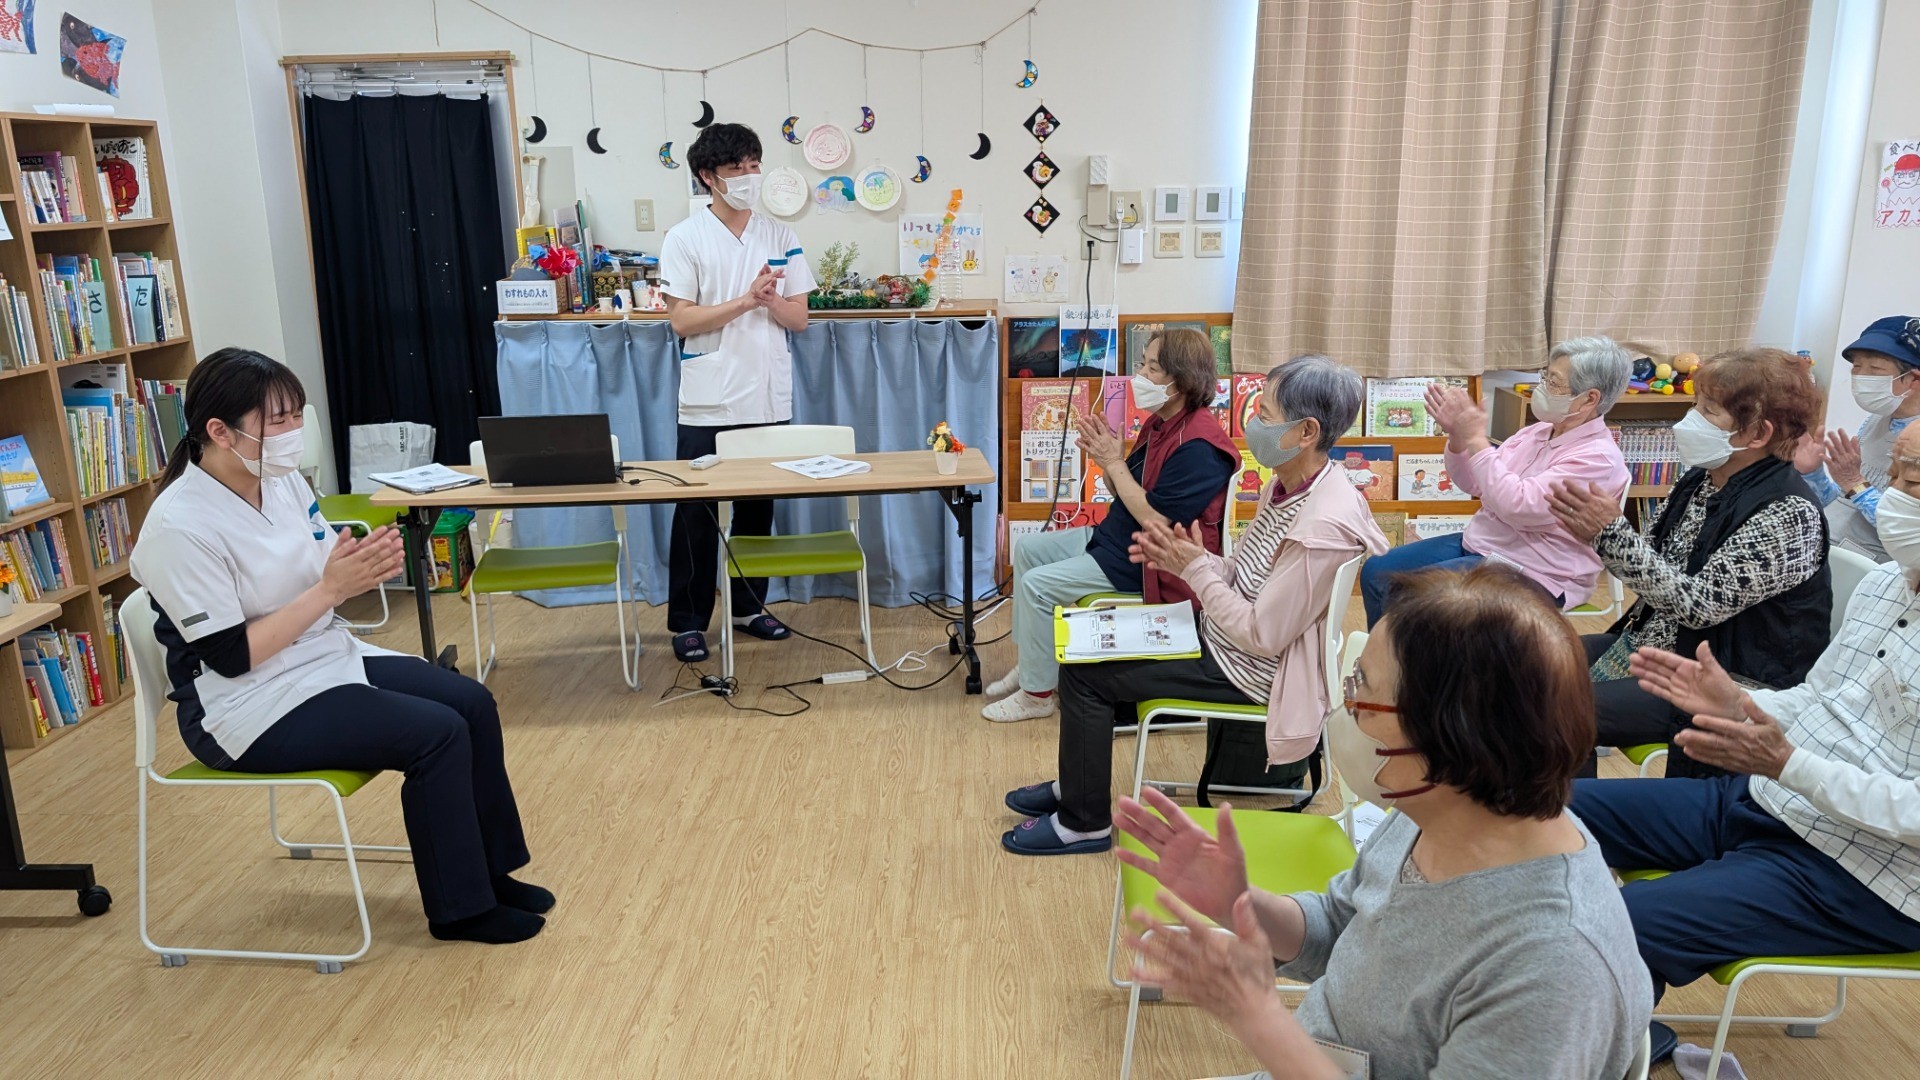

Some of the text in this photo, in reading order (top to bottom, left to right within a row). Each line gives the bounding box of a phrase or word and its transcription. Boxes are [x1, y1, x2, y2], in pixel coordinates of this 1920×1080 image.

[135, 285, 148, 307] た
[505, 288, 548, 298] わすれもの入れ
[88, 290, 102, 313] さ
[1013, 526, 1042, 534] だるまさ
